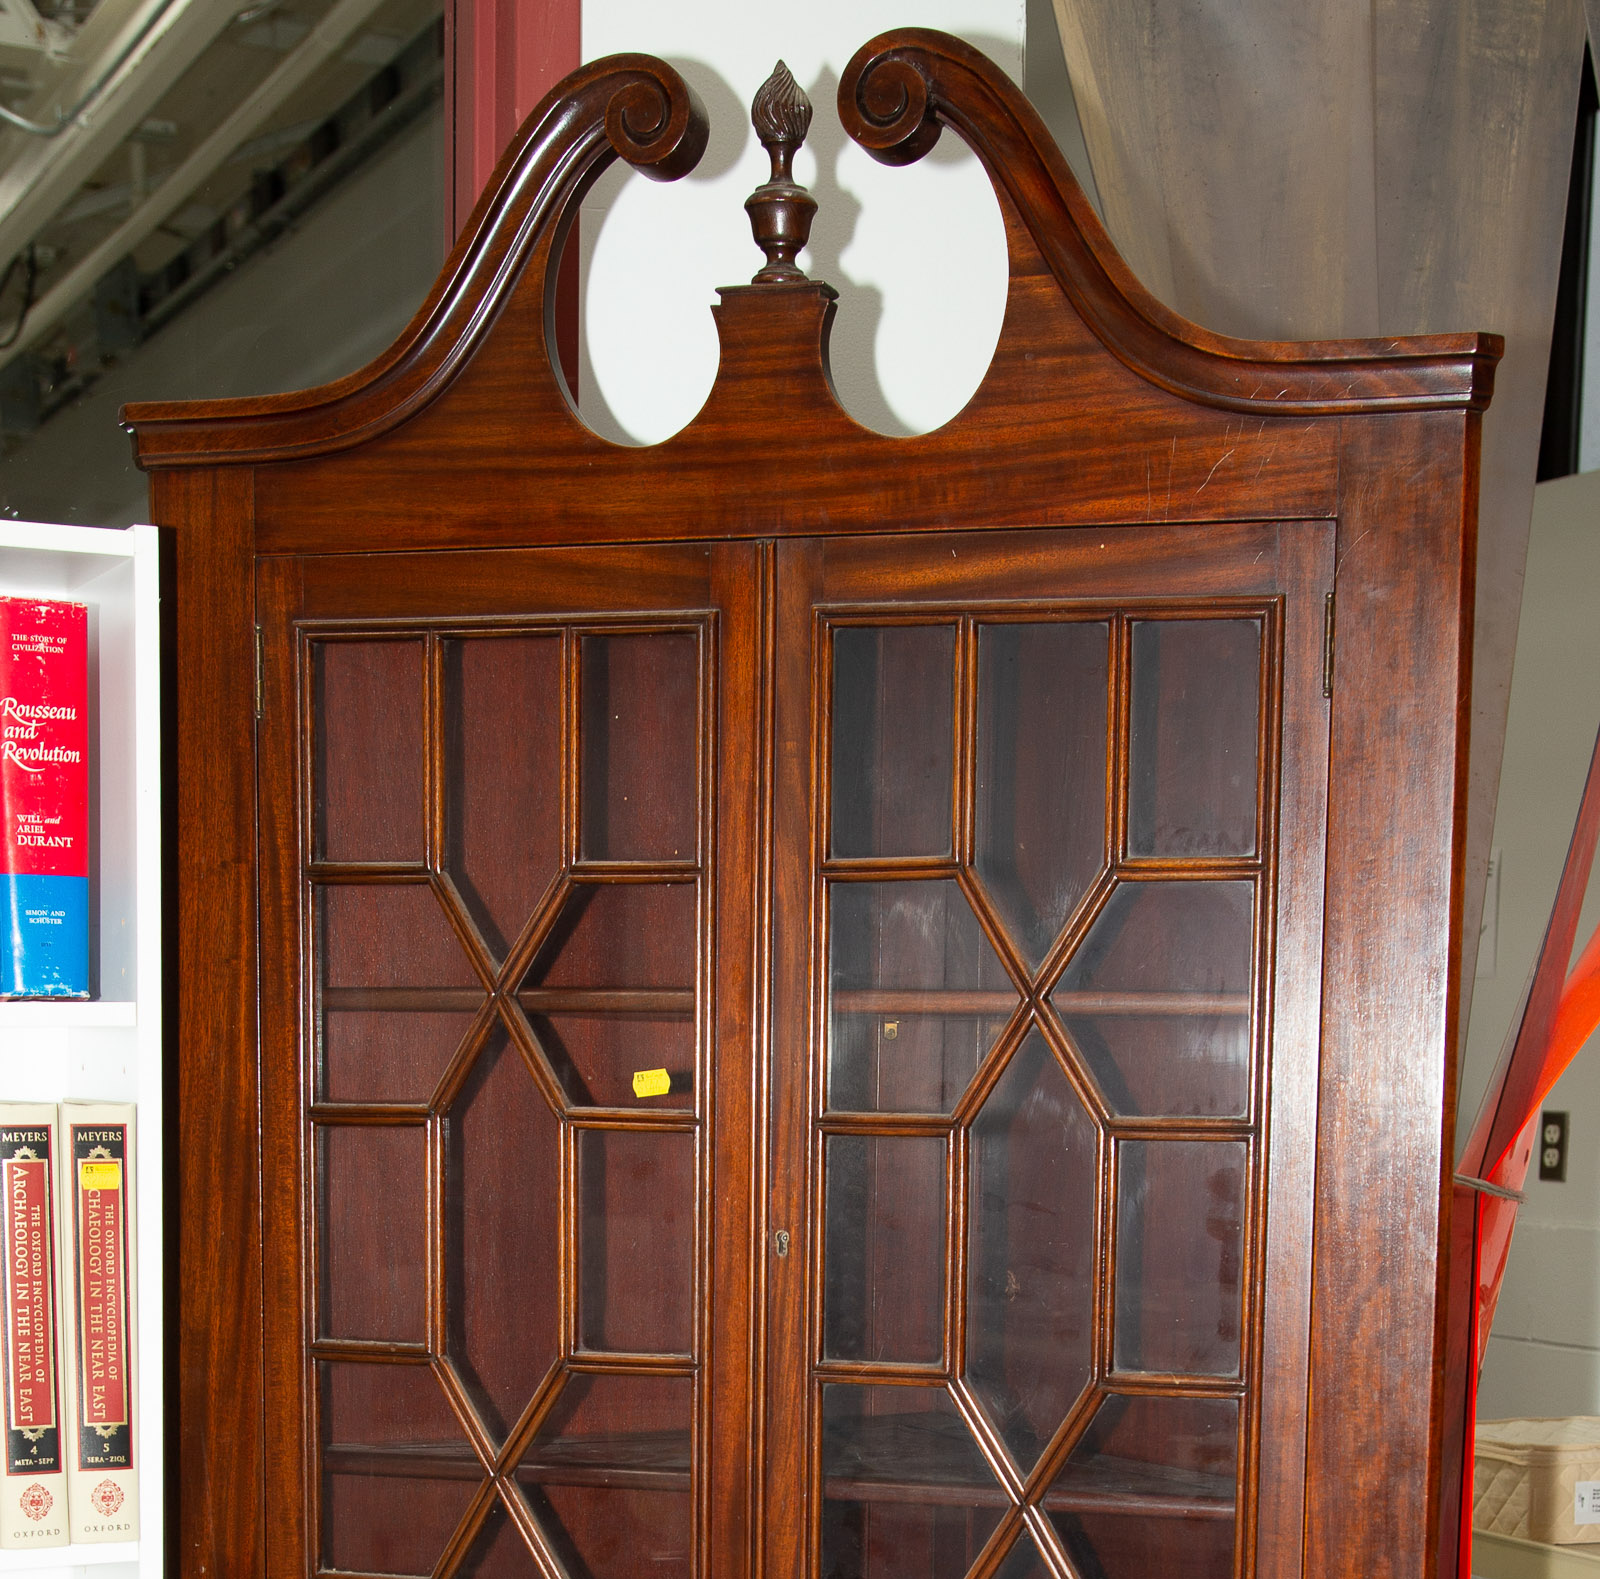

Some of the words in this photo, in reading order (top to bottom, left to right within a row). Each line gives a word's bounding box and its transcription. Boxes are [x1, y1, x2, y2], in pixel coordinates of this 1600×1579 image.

[12, 633, 28, 641] THE
[30, 634, 55, 643] STORY
[57, 636, 68, 644] OF
[12, 643, 64, 653] CIVILIZATION
[13, 653, 20, 661] X
[0, 697, 78, 726] Rousseau
[4, 719, 39, 739] and
[1, 740, 82, 772] Revolution
[17, 814, 43, 824] WILL
[44, 816, 61, 824] and
[17, 825, 46, 834] ARIEL
[17, 834, 74, 848] DURANT
[25, 909, 48, 917] SIMON
[50, 910, 66, 918] AND
[28, 917, 63, 925] SCHUSTER
[2, 1131, 48, 1142] MEYERS
[77, 1131, 122, 1142] MEYERS
[13, 1165, 30, 1279] ARCHAEOLOGY
[31, 1204, 41, 1228] THE
[105, 1203, 115, 1226] THE
[88, 1188, 102, 1278] CHAEOLOGY
[32, 1230, 42, 1278] OXFORD
[105, 1229, 116, 1276] OXFORD
[16, 1282, 30, 1301] IN
[90, 1281, 103, 1298] IN
[17, 1305, 31, 1337] THE
[33, 1280, 45, 1366] ENCYCLOPEDIA
[90, 1302, 104, 1334] THE
[106, 1278, 117, 1363] ENCYCLOPEDIA
[18, 1342, 32, 1383] NEAR
[91, 1339, 105, 1380] NEAR
[35, 1368, 45, 1383] OF
[108, 1365, 118, 1381] OF
[20, 1388, 34, 1423] EAST
[93, 1384, 106, 1419] EAST
[30, 1445, 38, 1455] 4
[102, 1443, 110, 1452] 5
[13, 1528, 61, 1538] OXFORD
[84, 1523, 131, 1533] OXFORD
